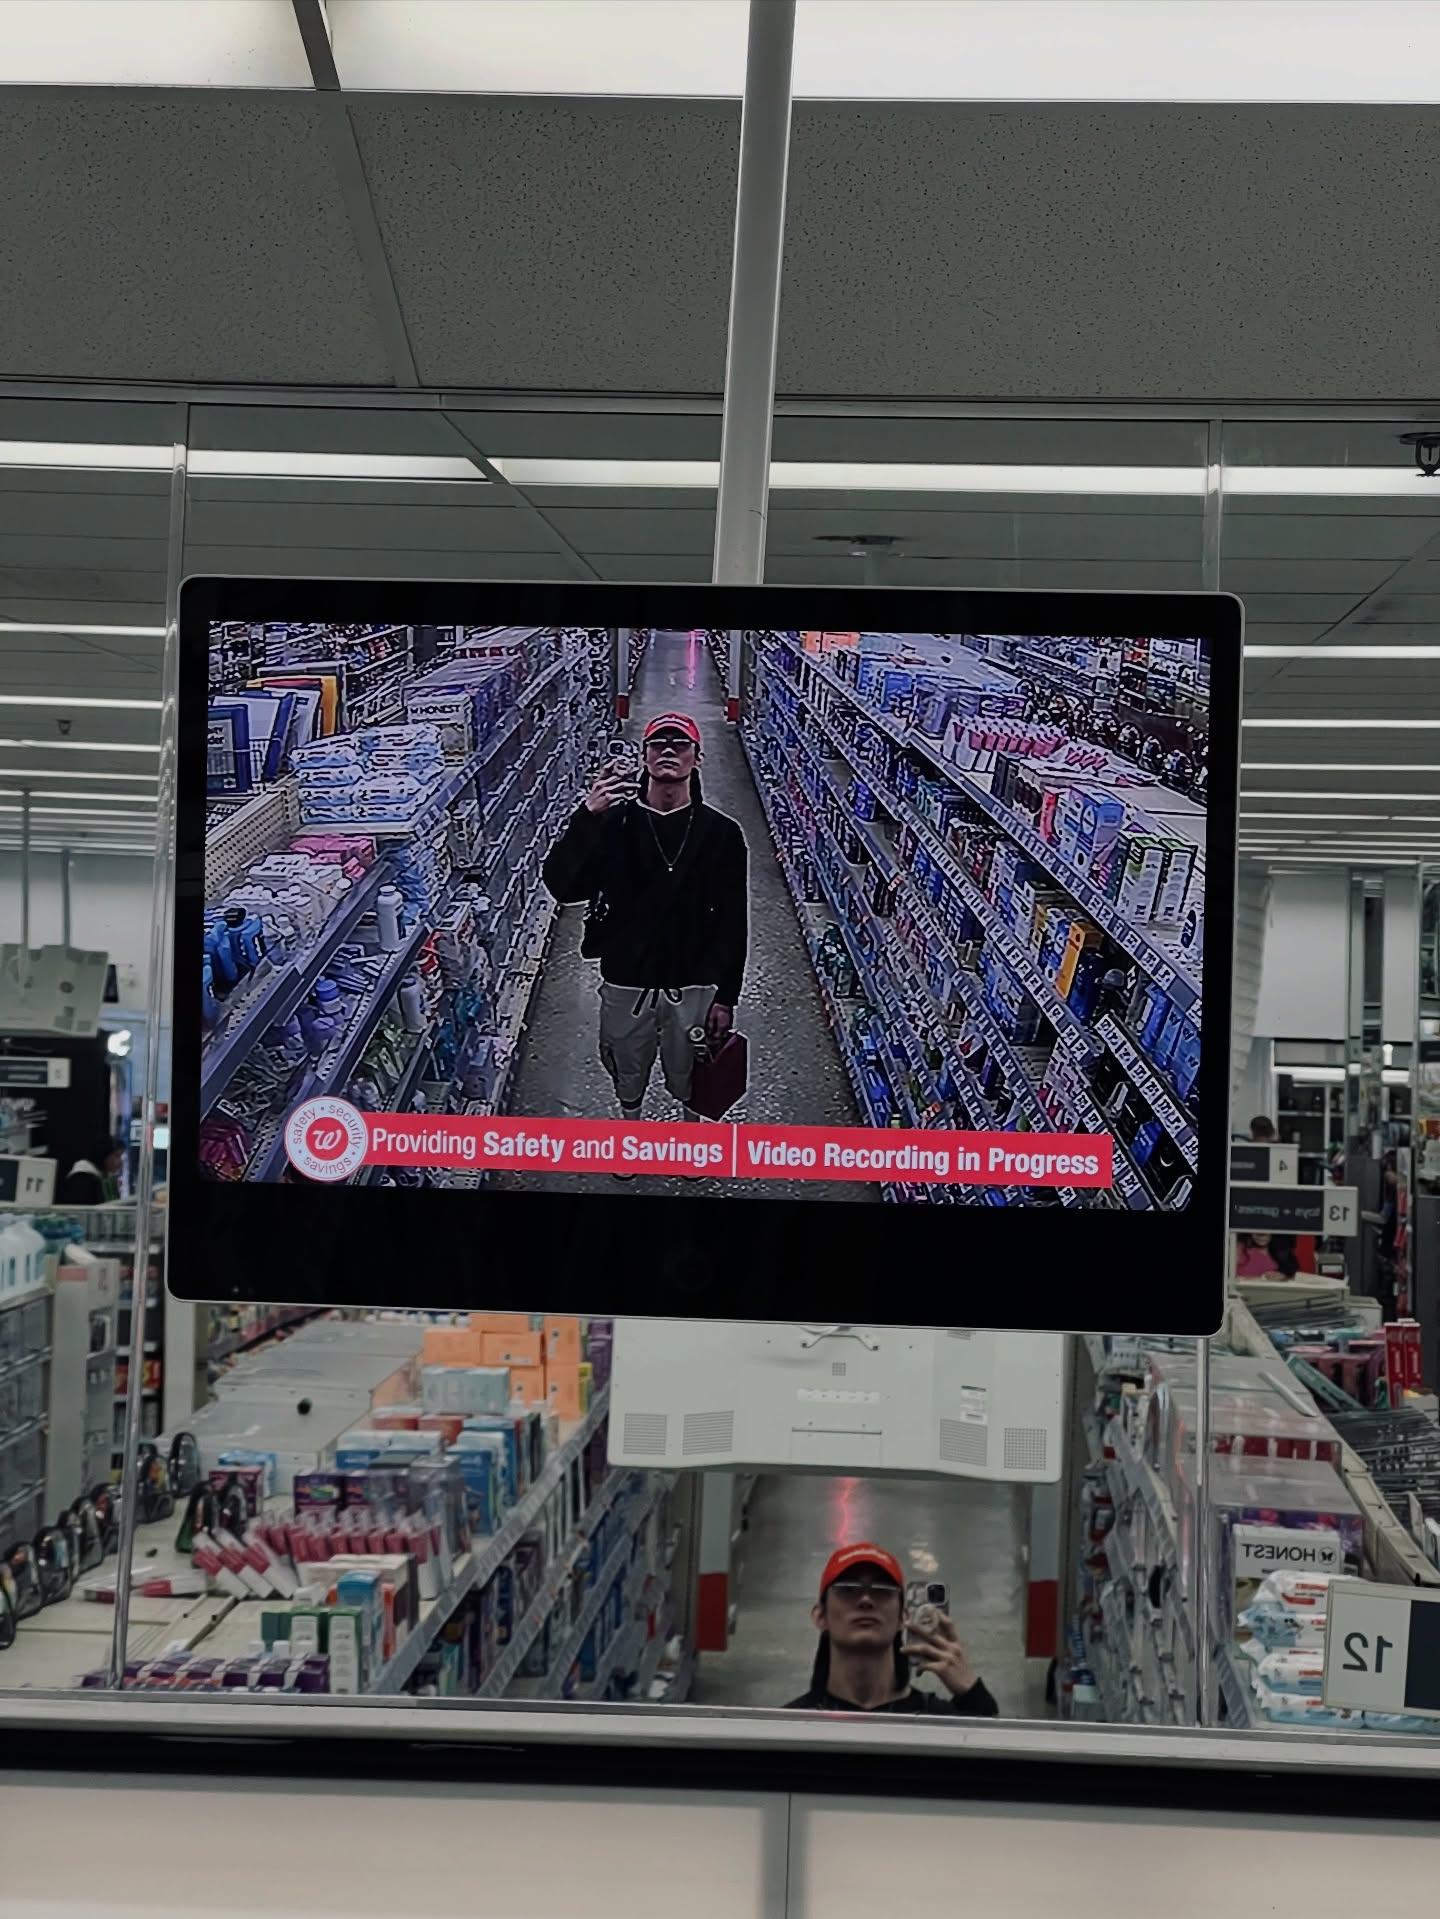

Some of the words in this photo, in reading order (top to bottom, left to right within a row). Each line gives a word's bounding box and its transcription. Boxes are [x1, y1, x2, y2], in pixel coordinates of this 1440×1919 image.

[419, 704, 461, 715] HONEST
[293, 1105, 317, 1145] safety
[328, 1104, 364, 1150] security
[303, 1155, 352, 1175] savings
[372, 1127, 476, 1160] Providing
[483, 1131, 565, 1163] Safety
[572, 1136, 614, 1160] and
[621, 1135, 723, 1168] Savings
[747, 1140, 817, 1167] Video
[824, 1143, 950, 1176] Recording
[958, 1147, 980, 1172] in
[988, 1147, 1099, 1179] Progress
